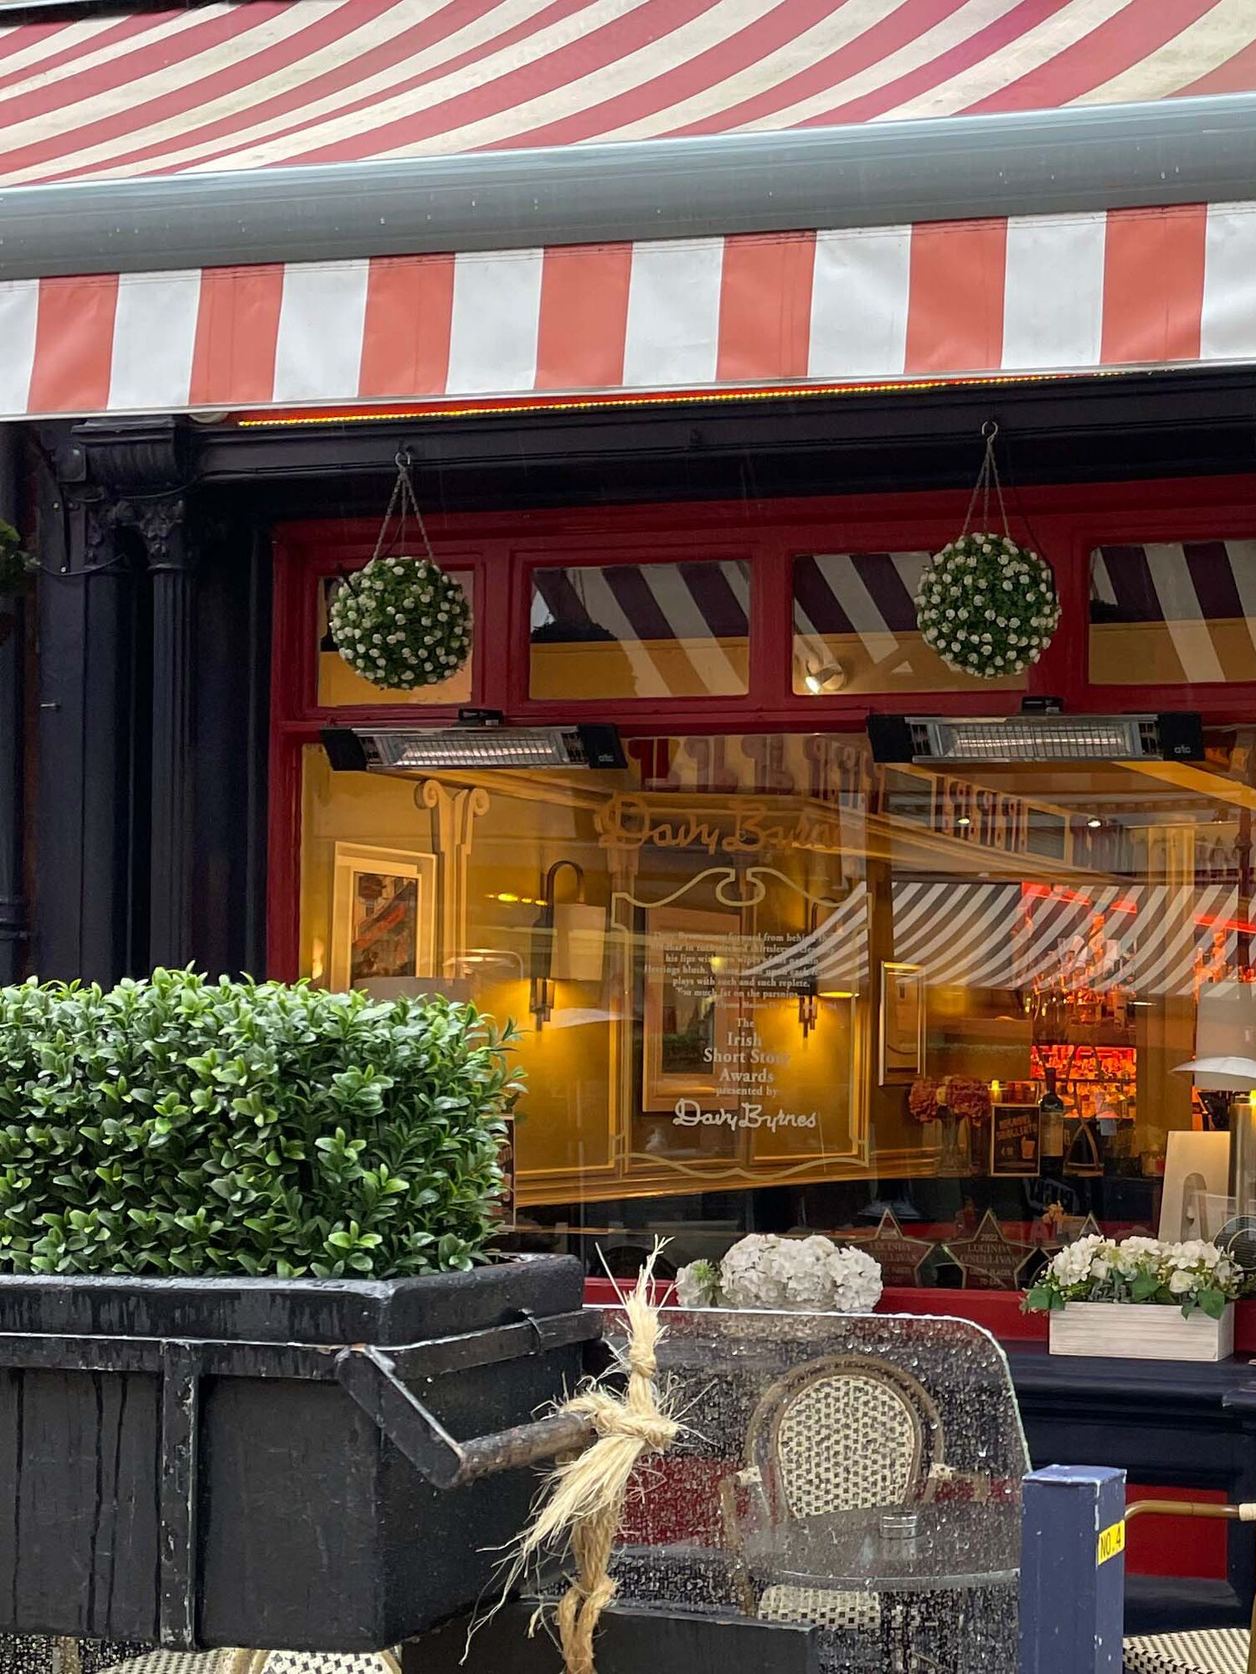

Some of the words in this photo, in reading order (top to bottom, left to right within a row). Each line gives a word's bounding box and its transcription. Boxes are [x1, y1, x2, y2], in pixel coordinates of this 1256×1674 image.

[594, 791, 721, 856] Davy
[763, 932, 784, 942] from
[787, 932, 816, 942] behi
[665, 953, 678, 963] his
[680, 953, 696, 965] lips
[673, 976, 694, 987] plays
[697, 976, 715, 985] with
[739, 976, 756, 986] and
[758, 977, 777, 986] such
[778, 979, 811, 989] replete.
[694, 987, 716, 996] much
[747, 987, 762, 997] the
[737, 1017, 755, 1028] The
[727, 1031, 762, 1046] Irish
[703, 1047, 746, 1063] Short
[719, 1068, 774, 1083] Awards
[716, 1086, 763, 1097] presented
[766, 1086, 778, 1097] by
[672, 1098, 737, 1131] Davy
[738, 1102, 817, 1133] Byrnes
